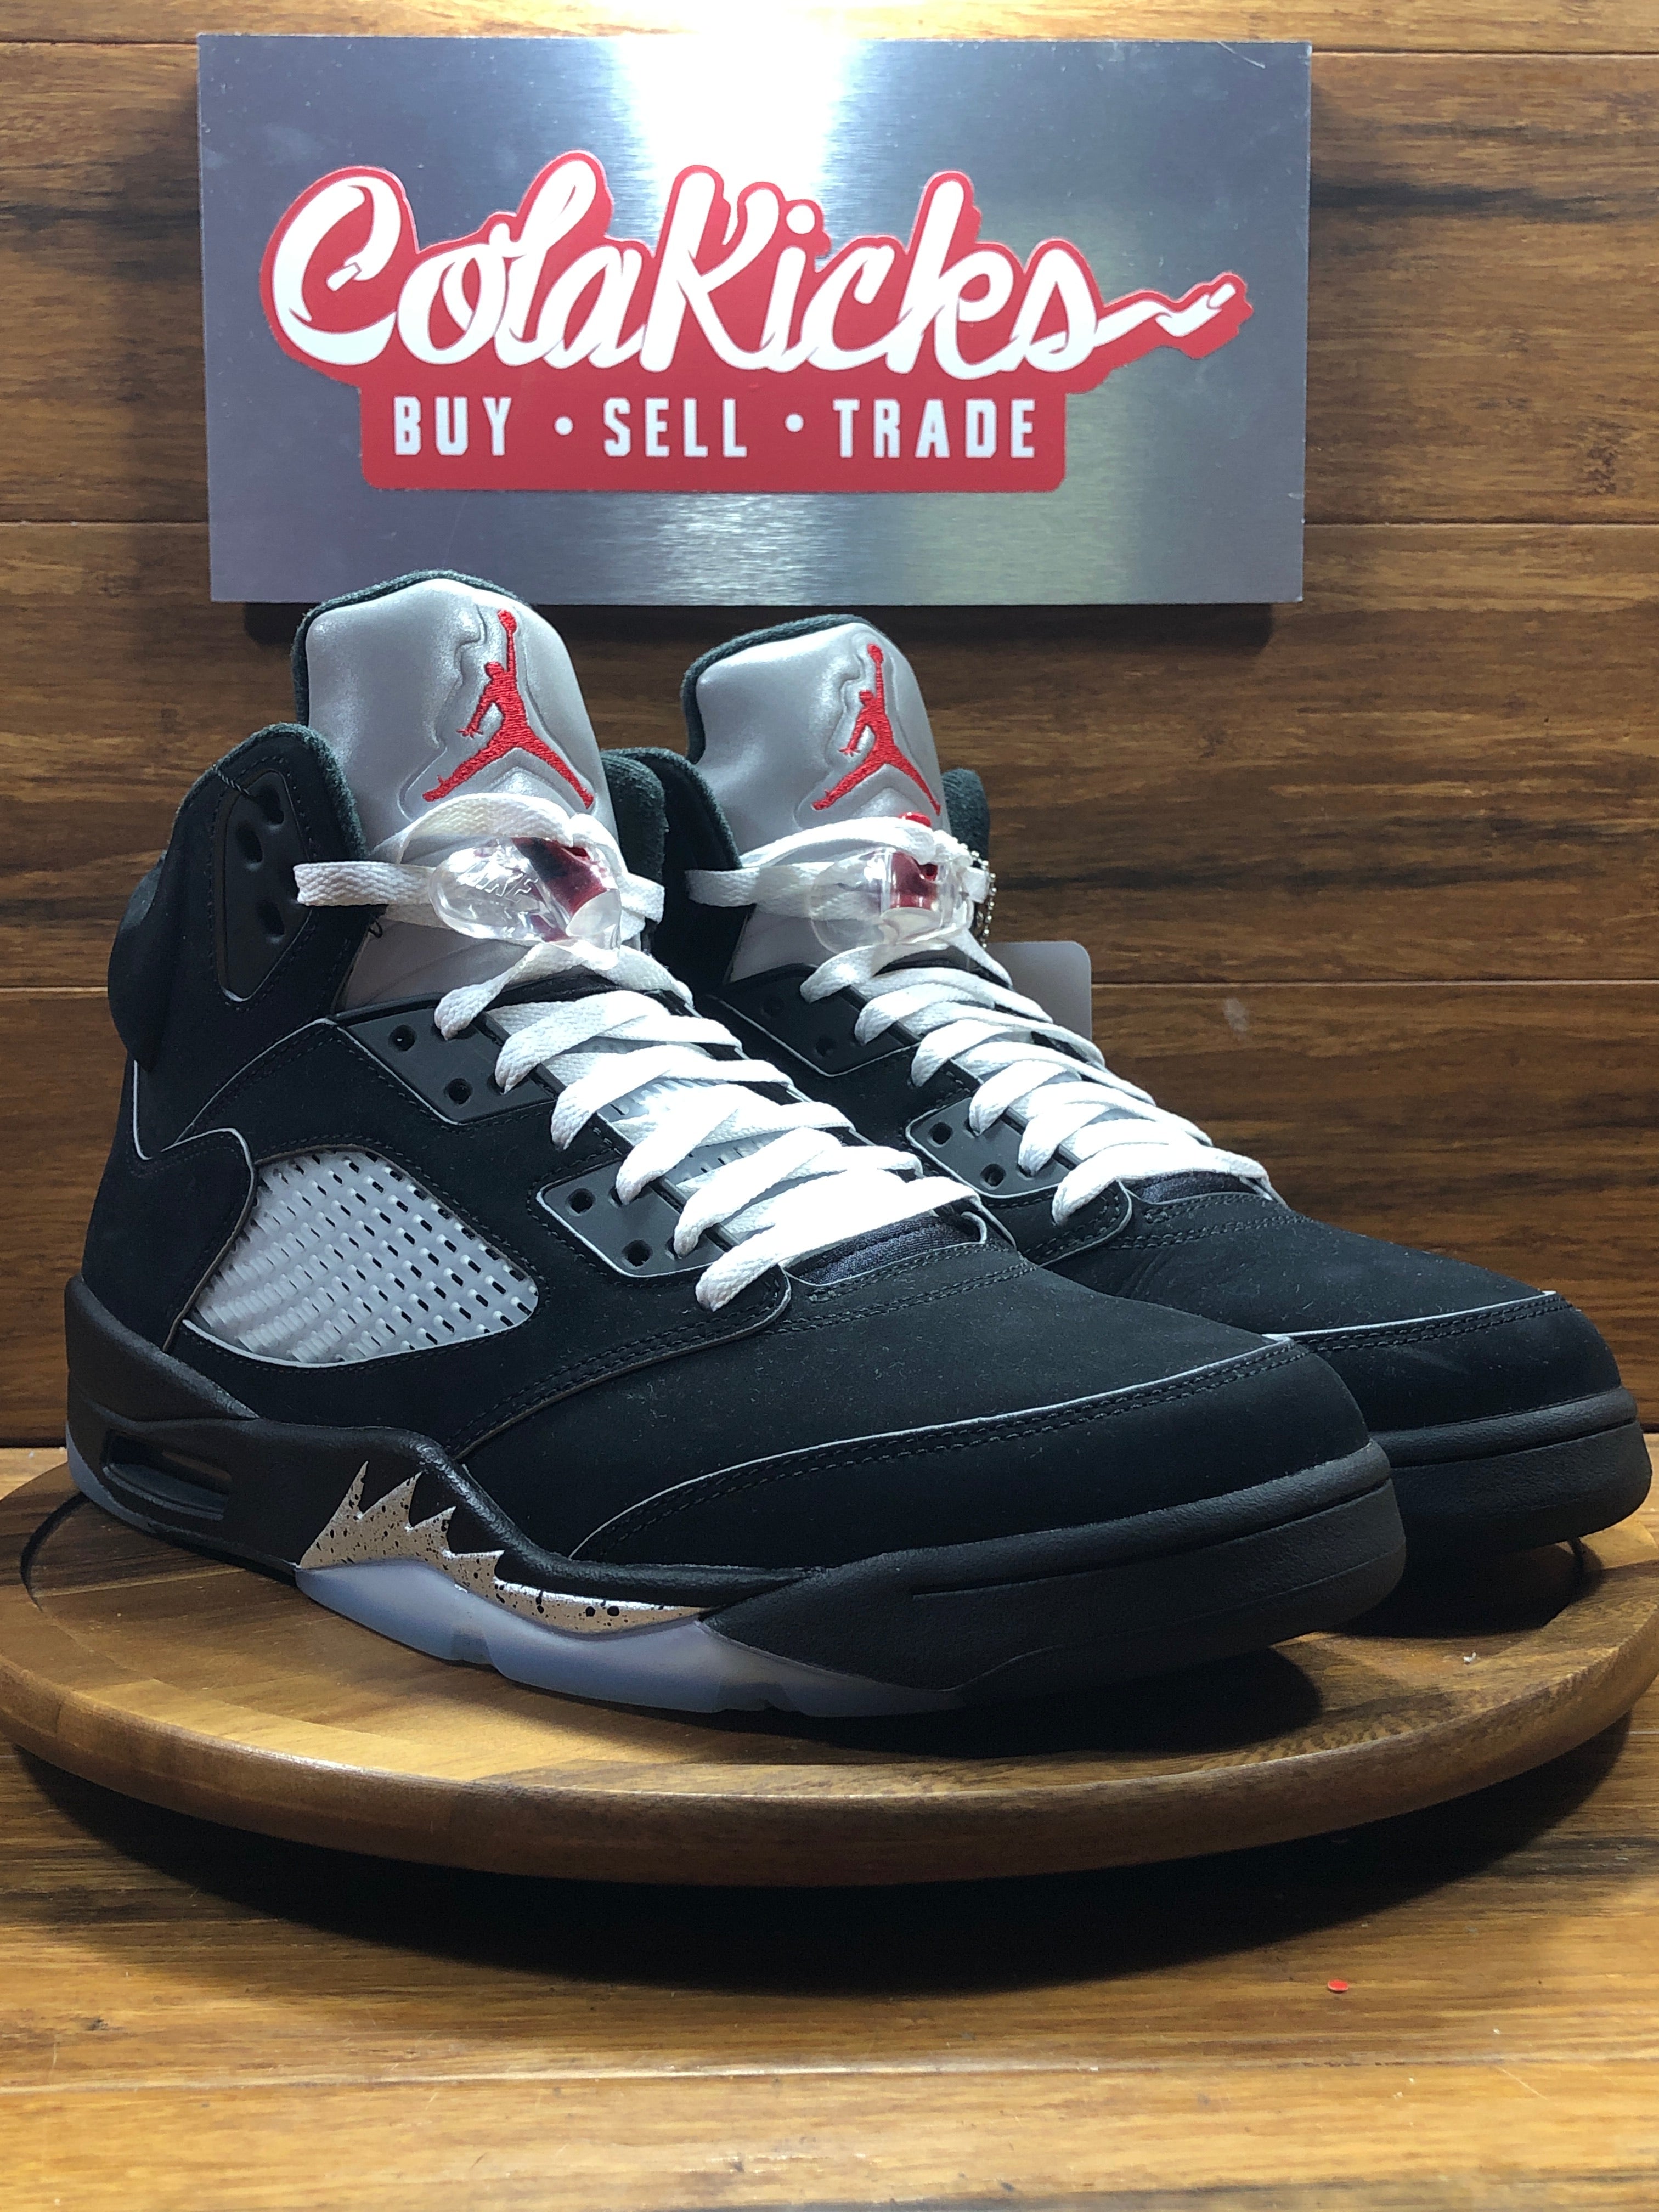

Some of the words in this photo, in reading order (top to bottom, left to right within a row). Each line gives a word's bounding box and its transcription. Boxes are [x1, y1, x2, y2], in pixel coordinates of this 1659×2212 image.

[393, 396, 512, 456] BUY
[603, 397, 748, 458] SELL
[832, 398, 1036, 458] TRADE
